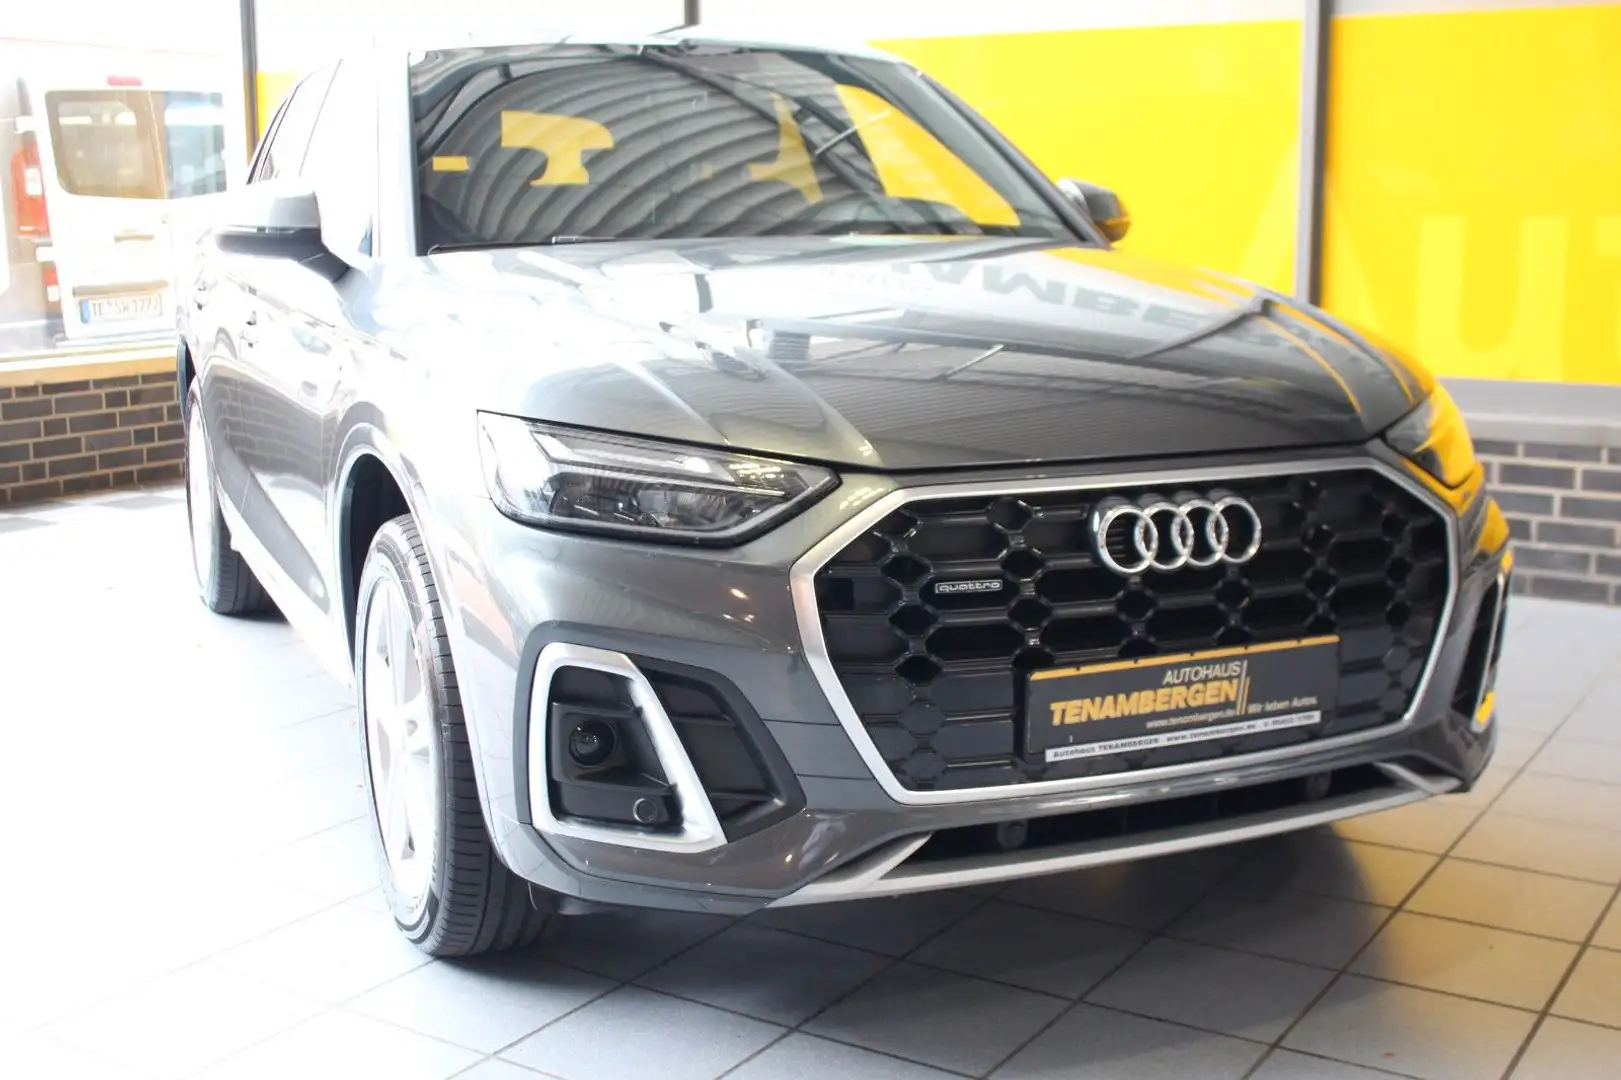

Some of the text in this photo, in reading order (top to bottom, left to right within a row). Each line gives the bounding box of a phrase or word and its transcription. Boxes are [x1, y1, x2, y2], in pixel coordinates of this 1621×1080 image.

[939, 582, 1000, 592] quattro
[1163, 660, 1242, 685] AUTOHAUS
[1050, 679, 1240, 726] TENAMBERGEN
